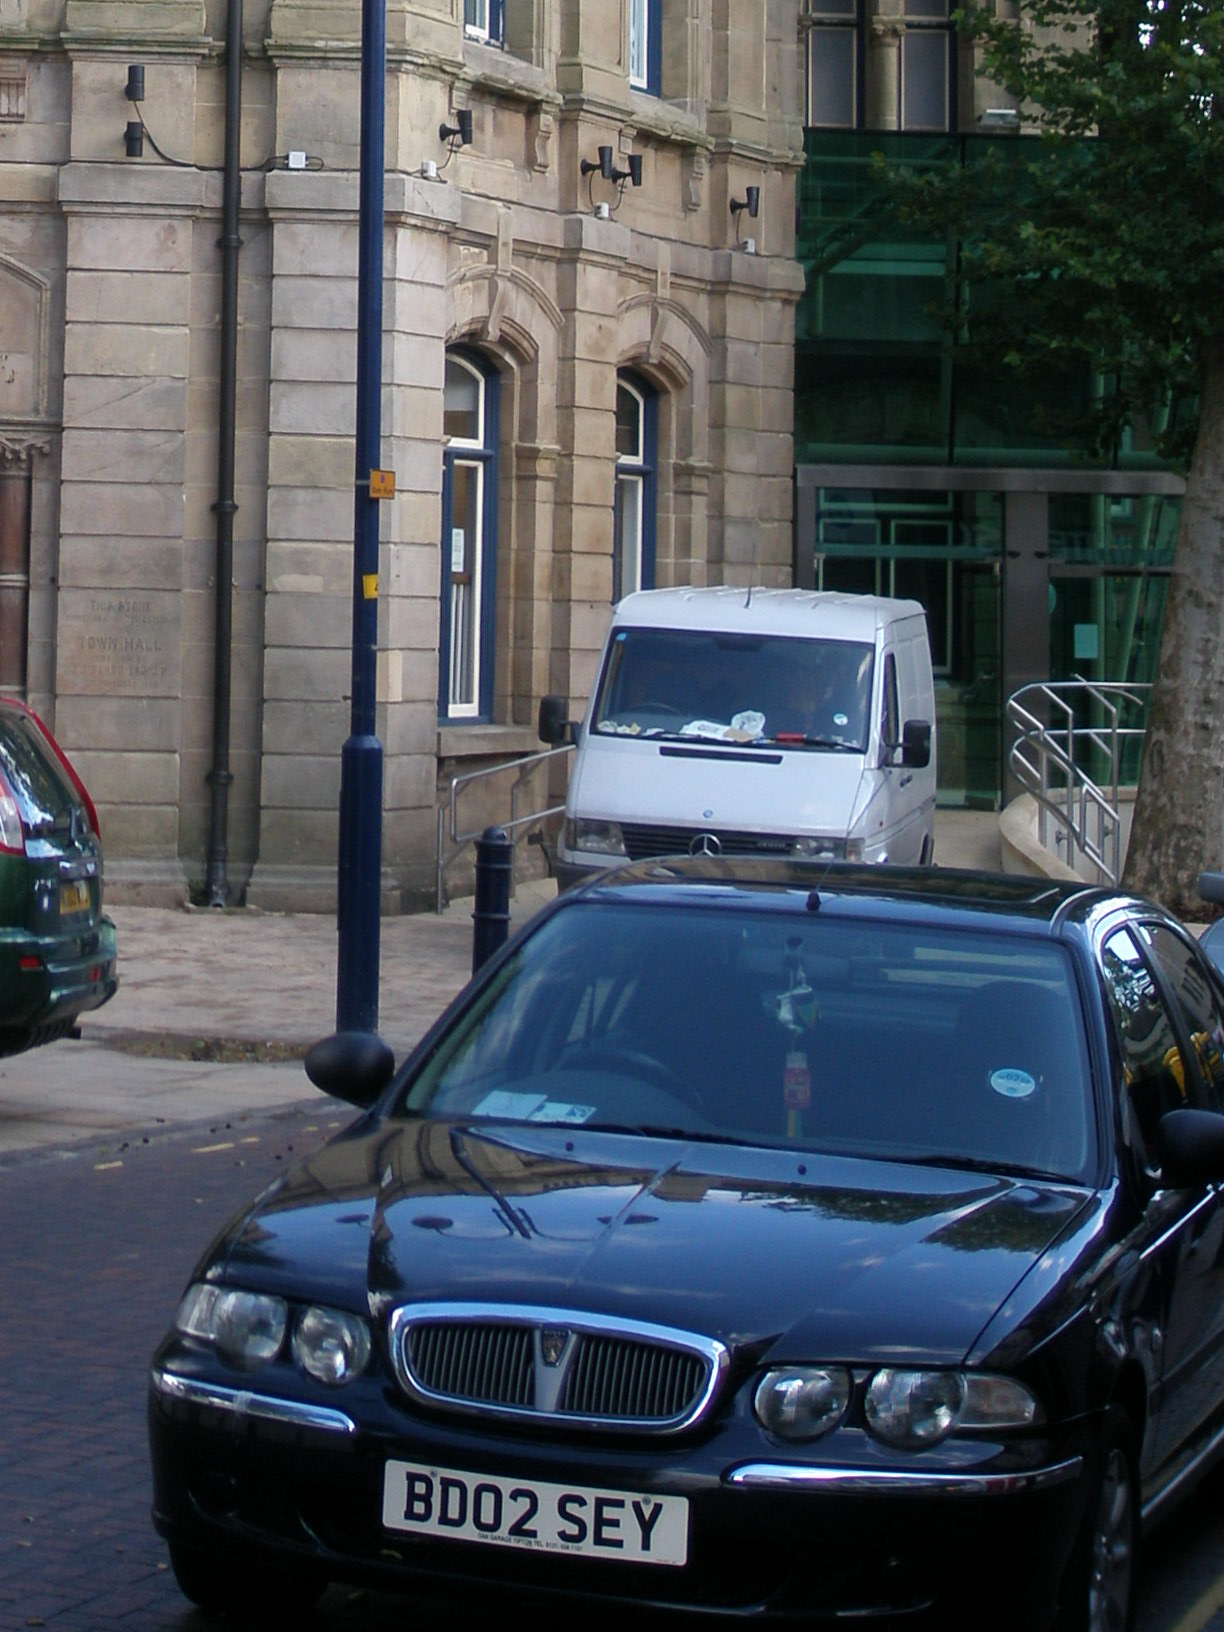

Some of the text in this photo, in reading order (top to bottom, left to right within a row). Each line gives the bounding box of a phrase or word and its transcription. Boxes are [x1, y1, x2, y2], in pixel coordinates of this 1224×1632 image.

[77, 635, 162, 651] TOWN HALL
[404, 1470, 664, 1552] BD02 SEY
